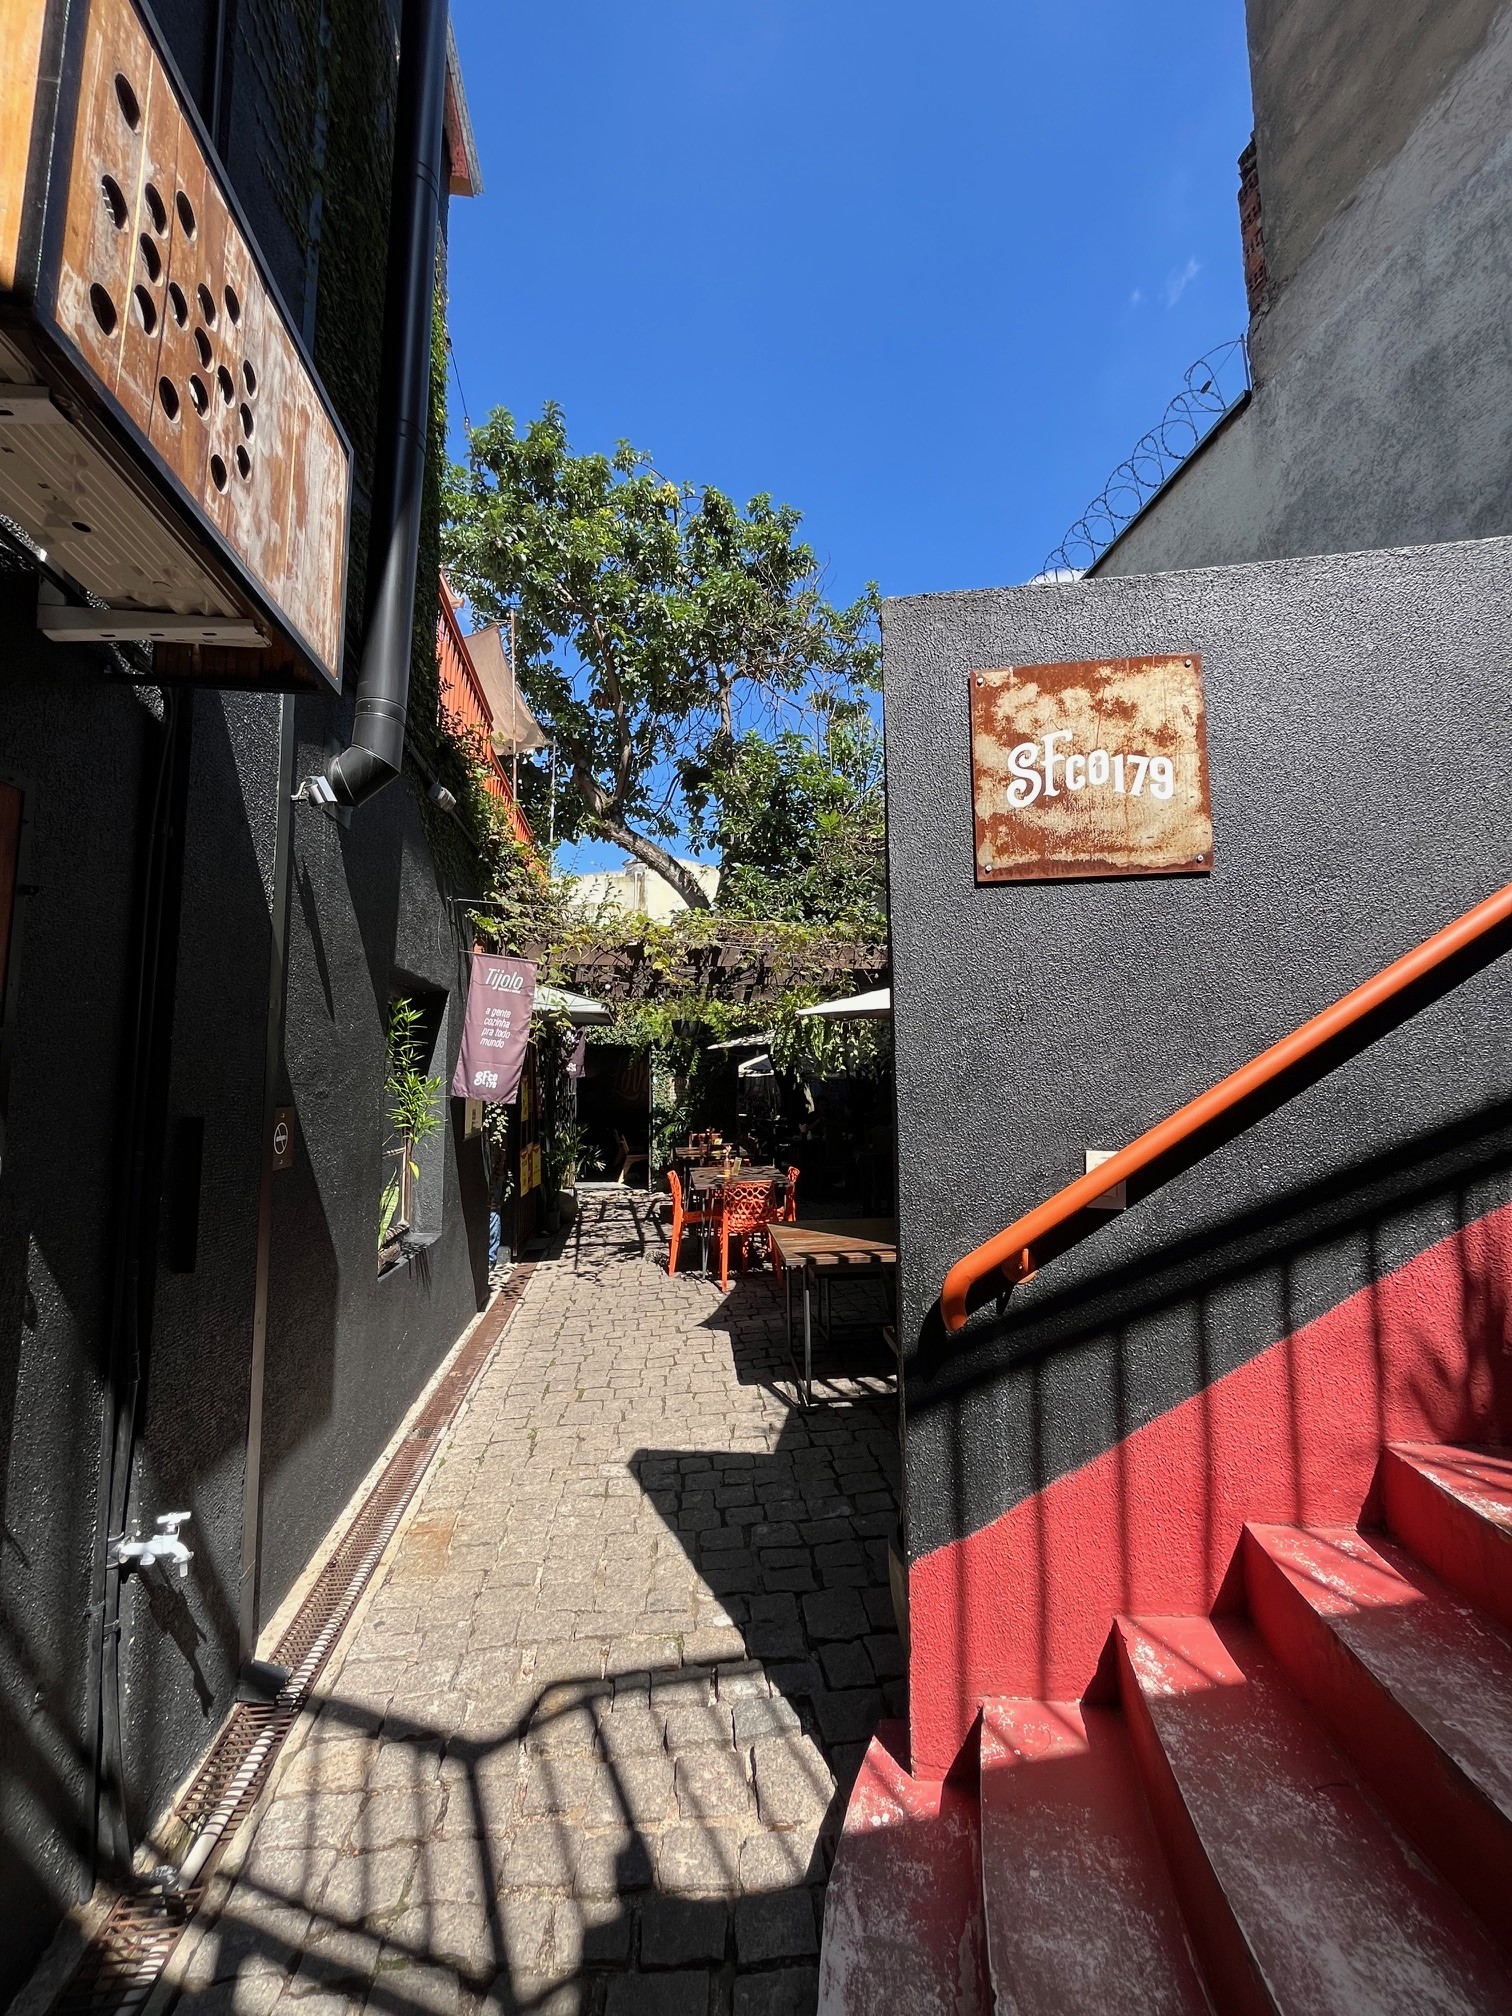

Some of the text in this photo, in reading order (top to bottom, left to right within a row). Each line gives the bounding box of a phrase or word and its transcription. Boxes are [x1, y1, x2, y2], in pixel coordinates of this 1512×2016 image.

[485, 967, 524, 990] Tijolo
[485, 1007, 512, 1018] a gente
[483, 1017, 511, 1029] cozinha
[480, 1027, 511, 1039] pra todo
[479, 1037, 505, 1049] mundo
